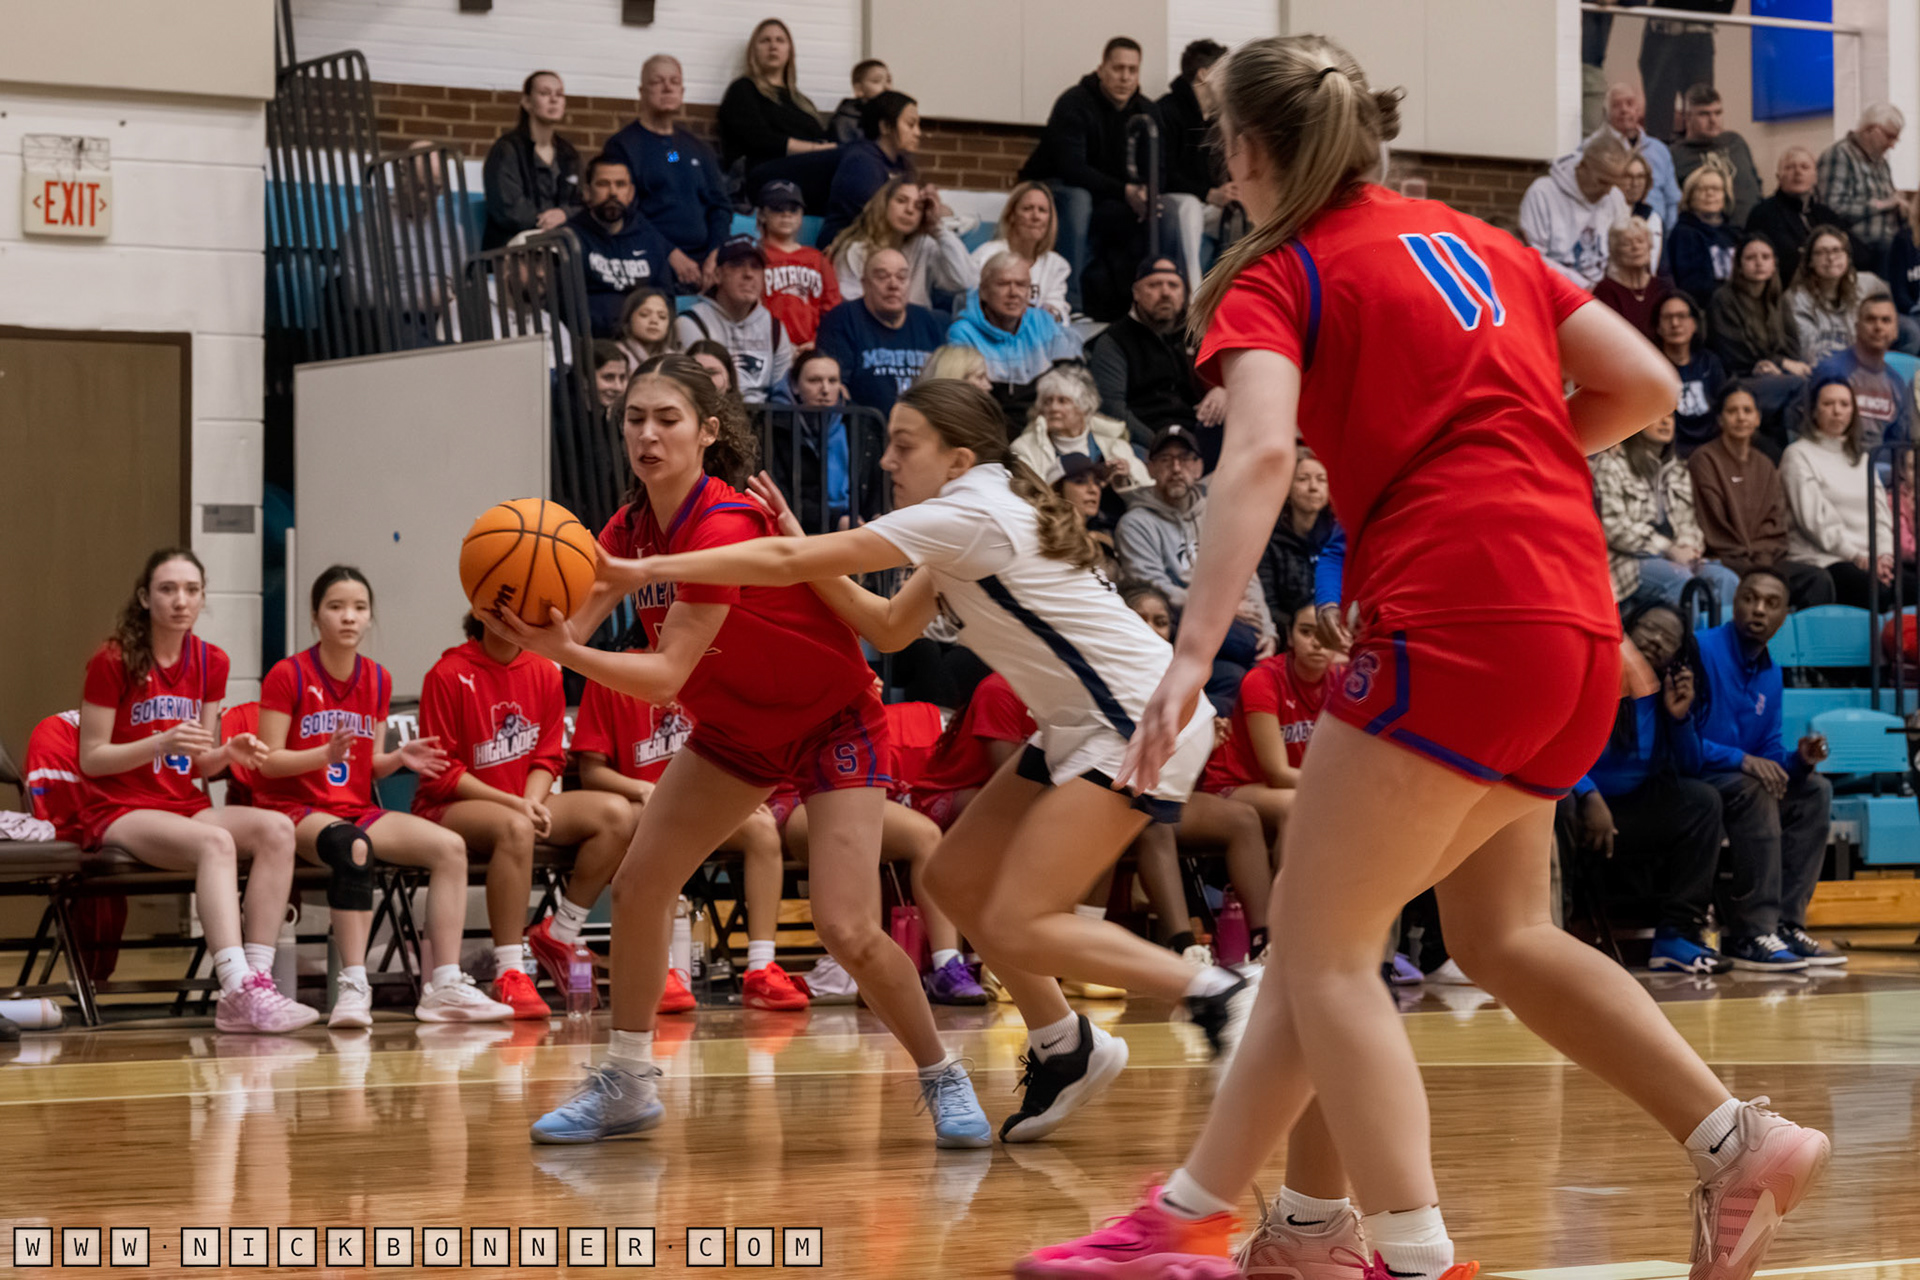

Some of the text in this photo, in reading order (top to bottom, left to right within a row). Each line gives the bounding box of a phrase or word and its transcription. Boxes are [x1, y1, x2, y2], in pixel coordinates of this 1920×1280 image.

[44, 180, 101, 227] EXIT
[763, 265, 823, 299] PATRIOTS
[1398, 231, 1506, 331] 11
[833, 741, 858, 775] S
